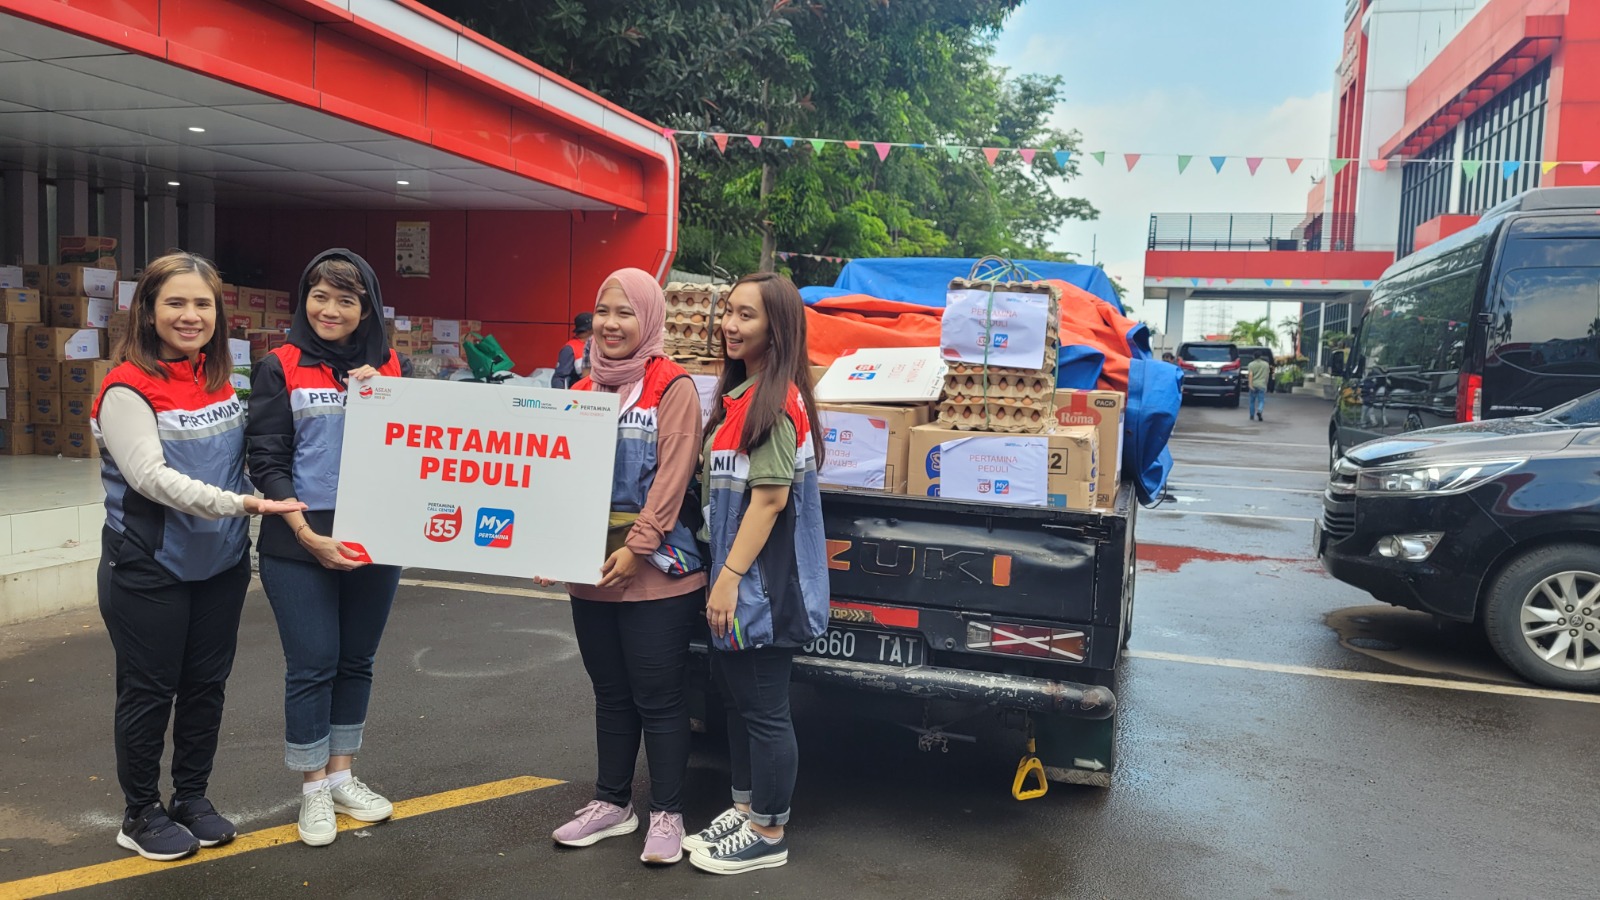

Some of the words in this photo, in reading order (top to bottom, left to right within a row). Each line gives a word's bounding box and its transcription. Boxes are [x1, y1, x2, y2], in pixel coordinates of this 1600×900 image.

[1061, 413, 1094, 425] Roma
[385, 422, 571, 460] PERTAMINA
[969, 454, 1018, 463] PERTAMINA
[420, 456, 531, 488] PEDULI
[978, 465, 1009, 473] PEDULI
[425, 518, 457, 538] 135
[478, 532, 509, 540] PERTAMINA
[825, 539, 1012, 587] ZUKI
[877, 634, 918, 664] TAT
